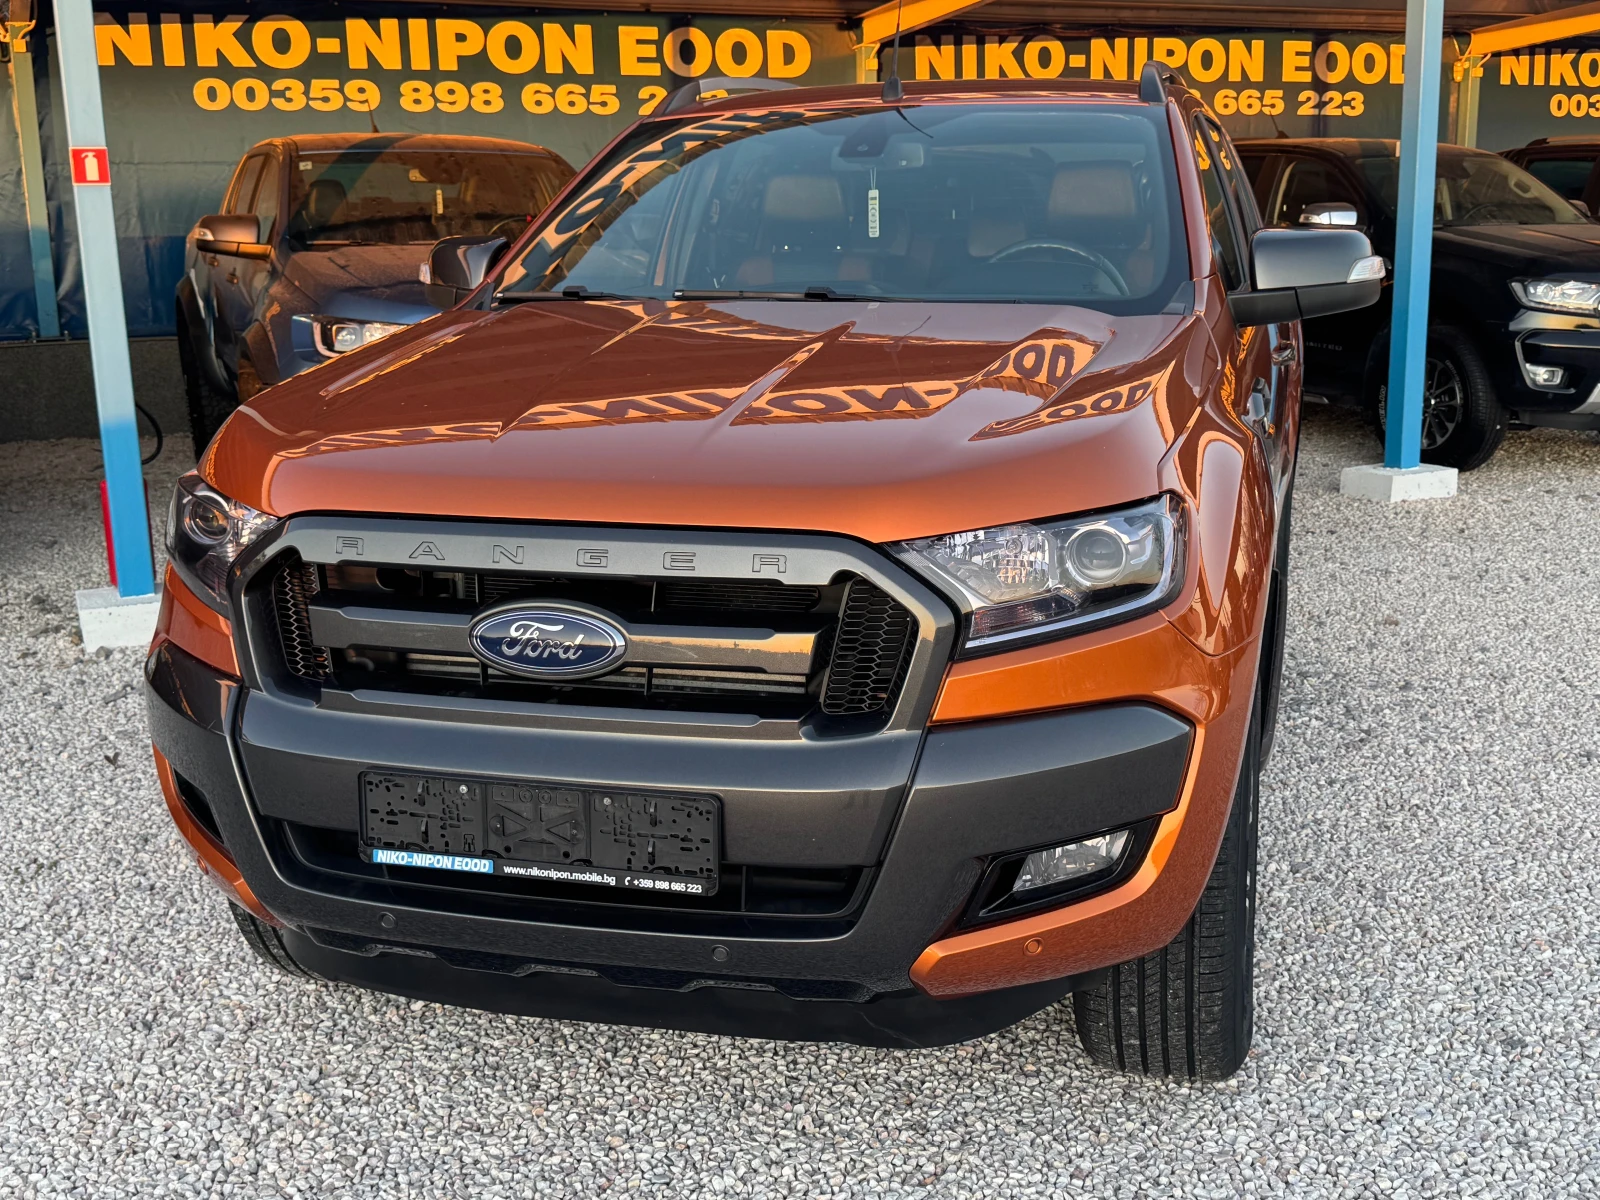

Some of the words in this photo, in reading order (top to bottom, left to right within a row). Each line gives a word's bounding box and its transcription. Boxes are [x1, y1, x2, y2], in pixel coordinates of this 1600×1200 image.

[93, 12, 594, 75] NIKO-NIPON
[619, 25, 812, 78] EOOD
[914, 34, 1265, 83] NIKO-NIPON
[193, 77, 381, 112] 00359
[400, 80, 505, 113] 898
[522, 82, 620, 116] 665
[1213, 88, 1285, 116] 665
[1297, 90, 1365, 117] 223
[335, 535, 788, 574] RANGER
[501, 620, 585, 660] Ford
[377, 850, 452, 870] NIKO-NIPON
[453, 859, 490, 873] EOOD
[503, 865, 616, 886] www.nikonipon.mobile.bg
[632, 878, 654, 889] +359
[654, 880, 670, 890] 898
[670, 882, 686, 892] 665
[686, 884, 702, 894] 223
